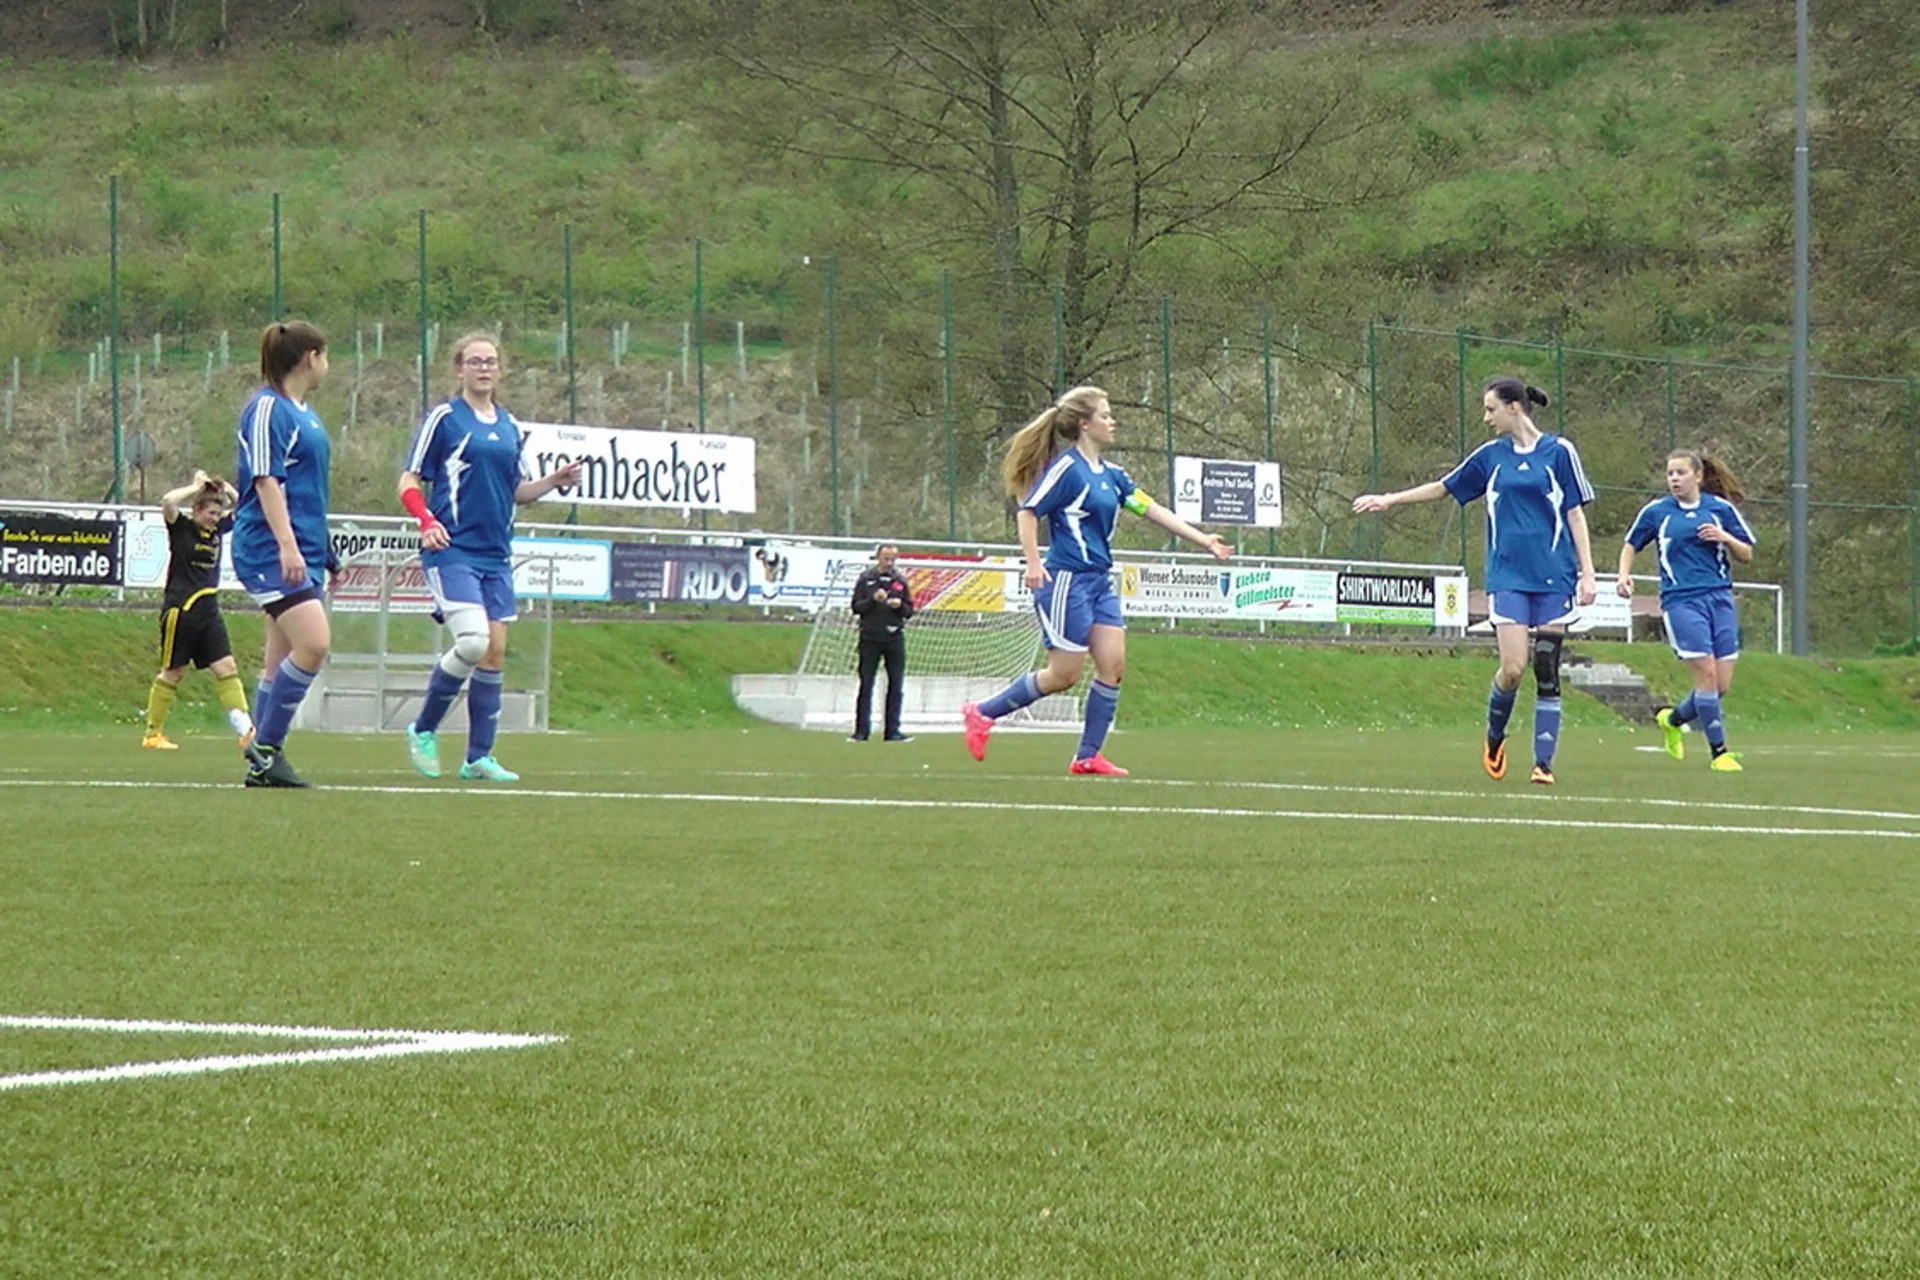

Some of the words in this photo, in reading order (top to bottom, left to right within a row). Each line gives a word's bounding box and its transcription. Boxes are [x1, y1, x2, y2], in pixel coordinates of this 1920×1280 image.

[519, 431, 726, 504] rombacher
[682, 561, 748, 601] RIDO
[1140, 568, 1169, 584] Werner
[1171, 568, 1217, 585] Schumacher
[1339, 576, 1433, 603] SHIRTWORLD24.de
